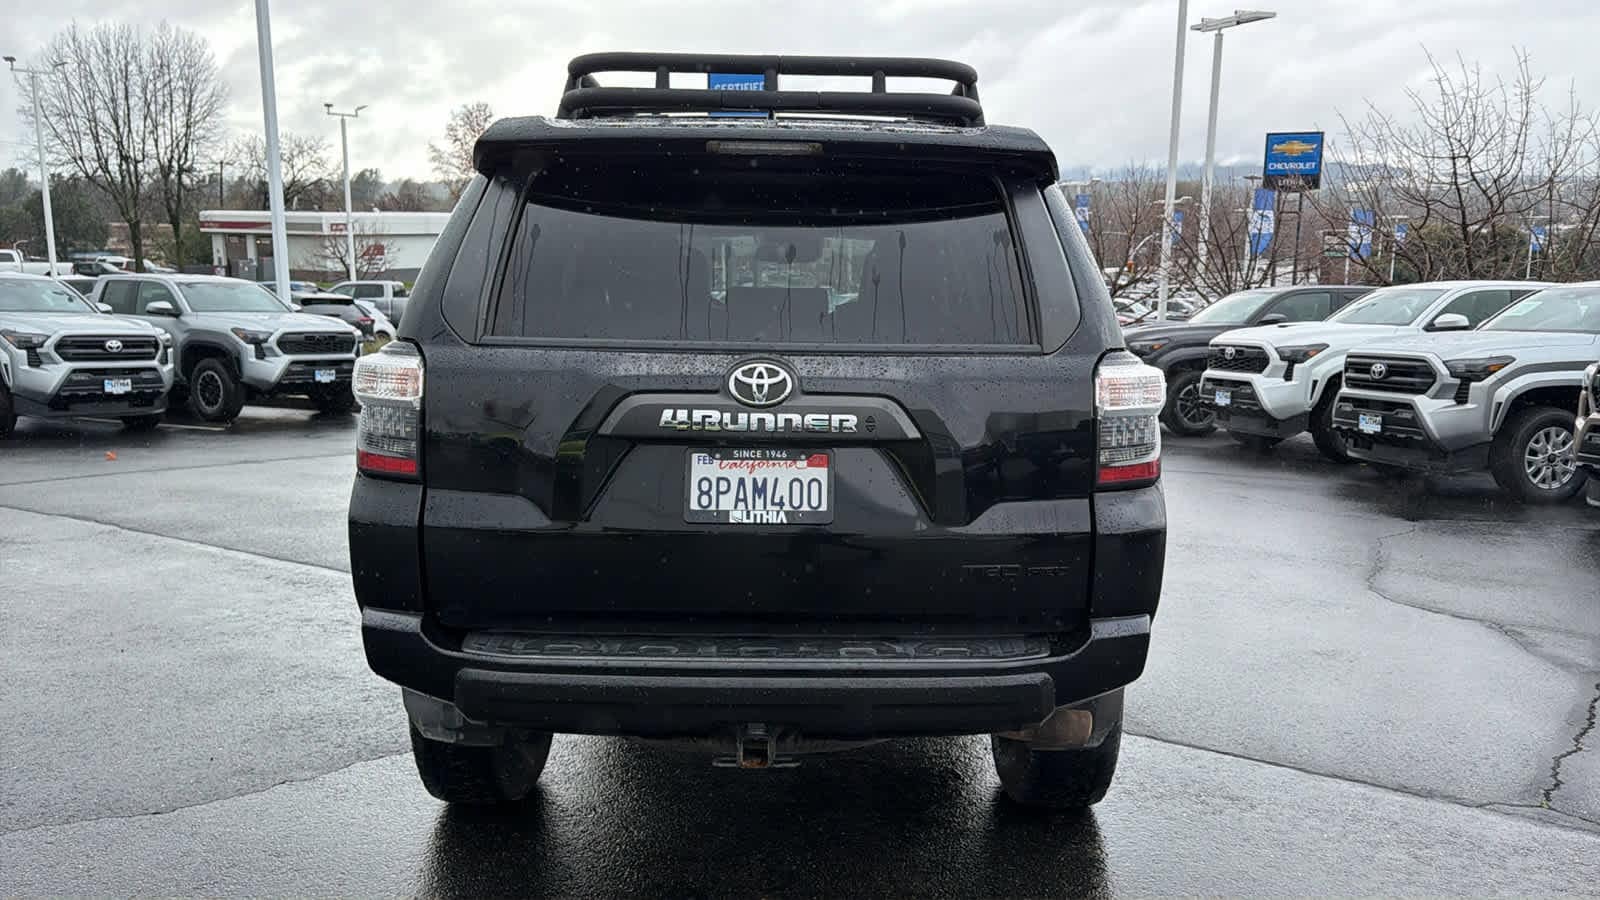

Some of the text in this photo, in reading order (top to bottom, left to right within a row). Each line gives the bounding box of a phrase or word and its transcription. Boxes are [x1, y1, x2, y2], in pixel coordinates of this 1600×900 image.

[714, 81, 765, 91] CERTIFIE
[1268, 162, 1316, 170] CHEVROLET
[658, 408, 858, 432] 4RUNNER
[733, 450, 788, 458] SINCE 1946
[697, 455, 714, 465] FEB
[697, 477, 823, 510] 8PAM400
[743, 511, 787, 524] LITHIA
